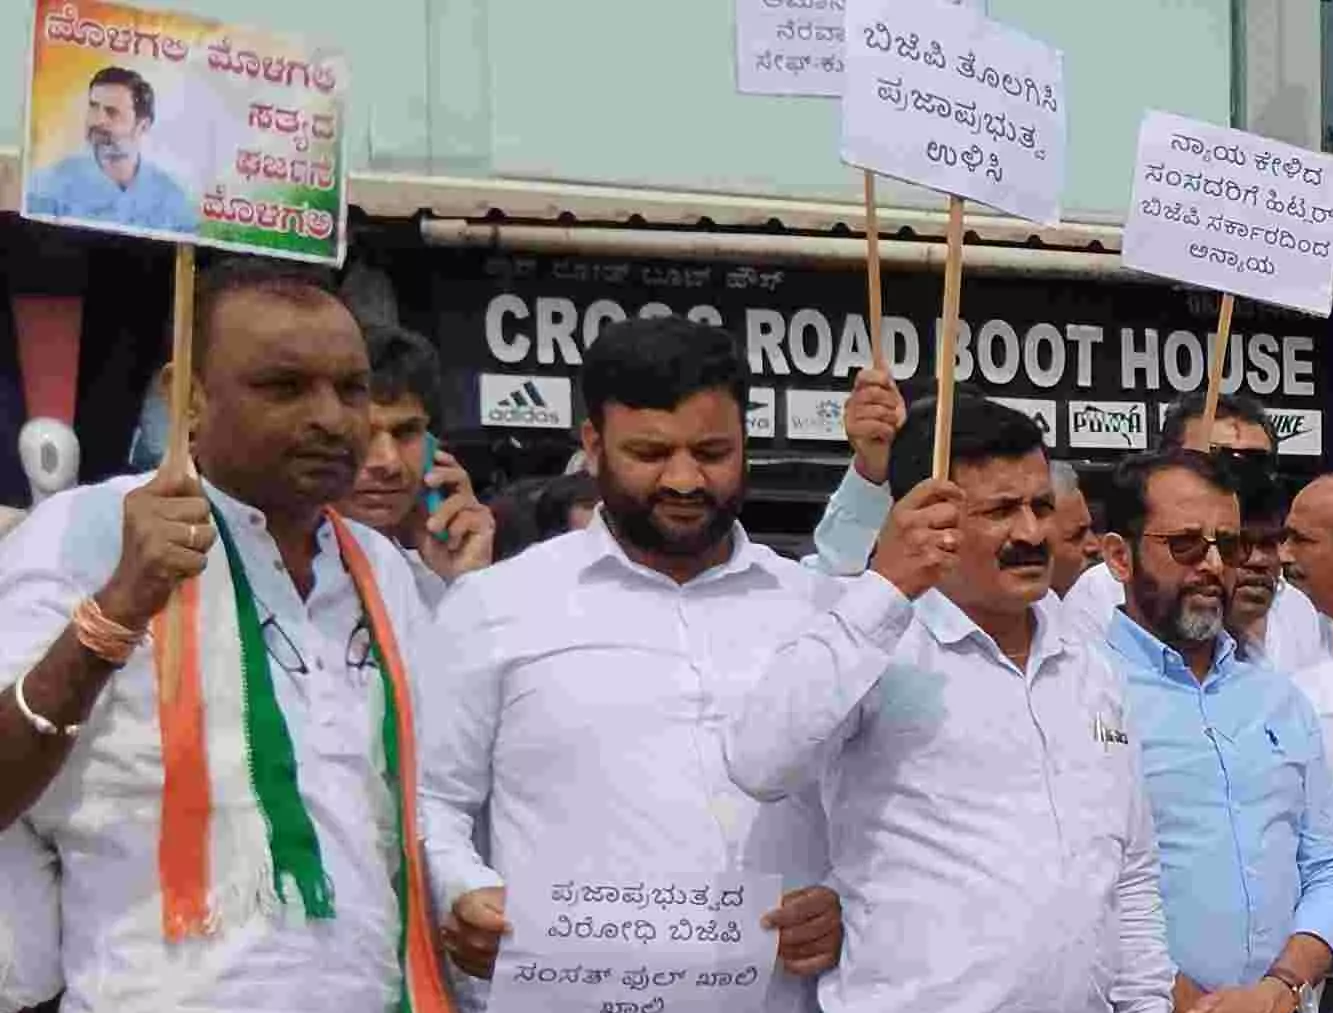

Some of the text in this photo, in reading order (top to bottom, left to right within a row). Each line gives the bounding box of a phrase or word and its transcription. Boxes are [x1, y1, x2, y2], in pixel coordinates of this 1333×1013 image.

[864, 22, 1057, 112] ಬಿಜೆಪಿ ತೊಲಗಿಸಿ
[249, 102, 334, 151] ಸತ್ಯದ
[878, 77, 1047, 160] ಪ್ರಜಾಪ್ರಭುತ್ವ
[927, 140, 1003, 183] ಉಳಿಸಿ
[1171, 133, 1323, 186] ನ್ಯಾಯ ಕೇಳಿದ
[1145, 163, 1259, 206] ಸಂಸದರಿಗೆ
[1142, 197, 1330, 257] ಬಿಜೆಪಿ ಸರ್ಕಾರದಿಂದ
[1190, 241, 1275, 274] ಅನ್ಯಾಯ
[746, 308, 919, 381] ROAD
[935, 318, 1103, 388] BOOT
[1120, 328, 1314, 396] HOUSE
[551, 881, 744, 911] ಪ್ರಜಾಪ್ರಭುತ್ವದ
[548, 915, 742, 944] ವಿರೋಧಿ ಬಿಜೆಪಿ
[514, 963, 610, 984] ಸಂಸತ್
[696, 966, 758, 987] ಖಾಲಿ
